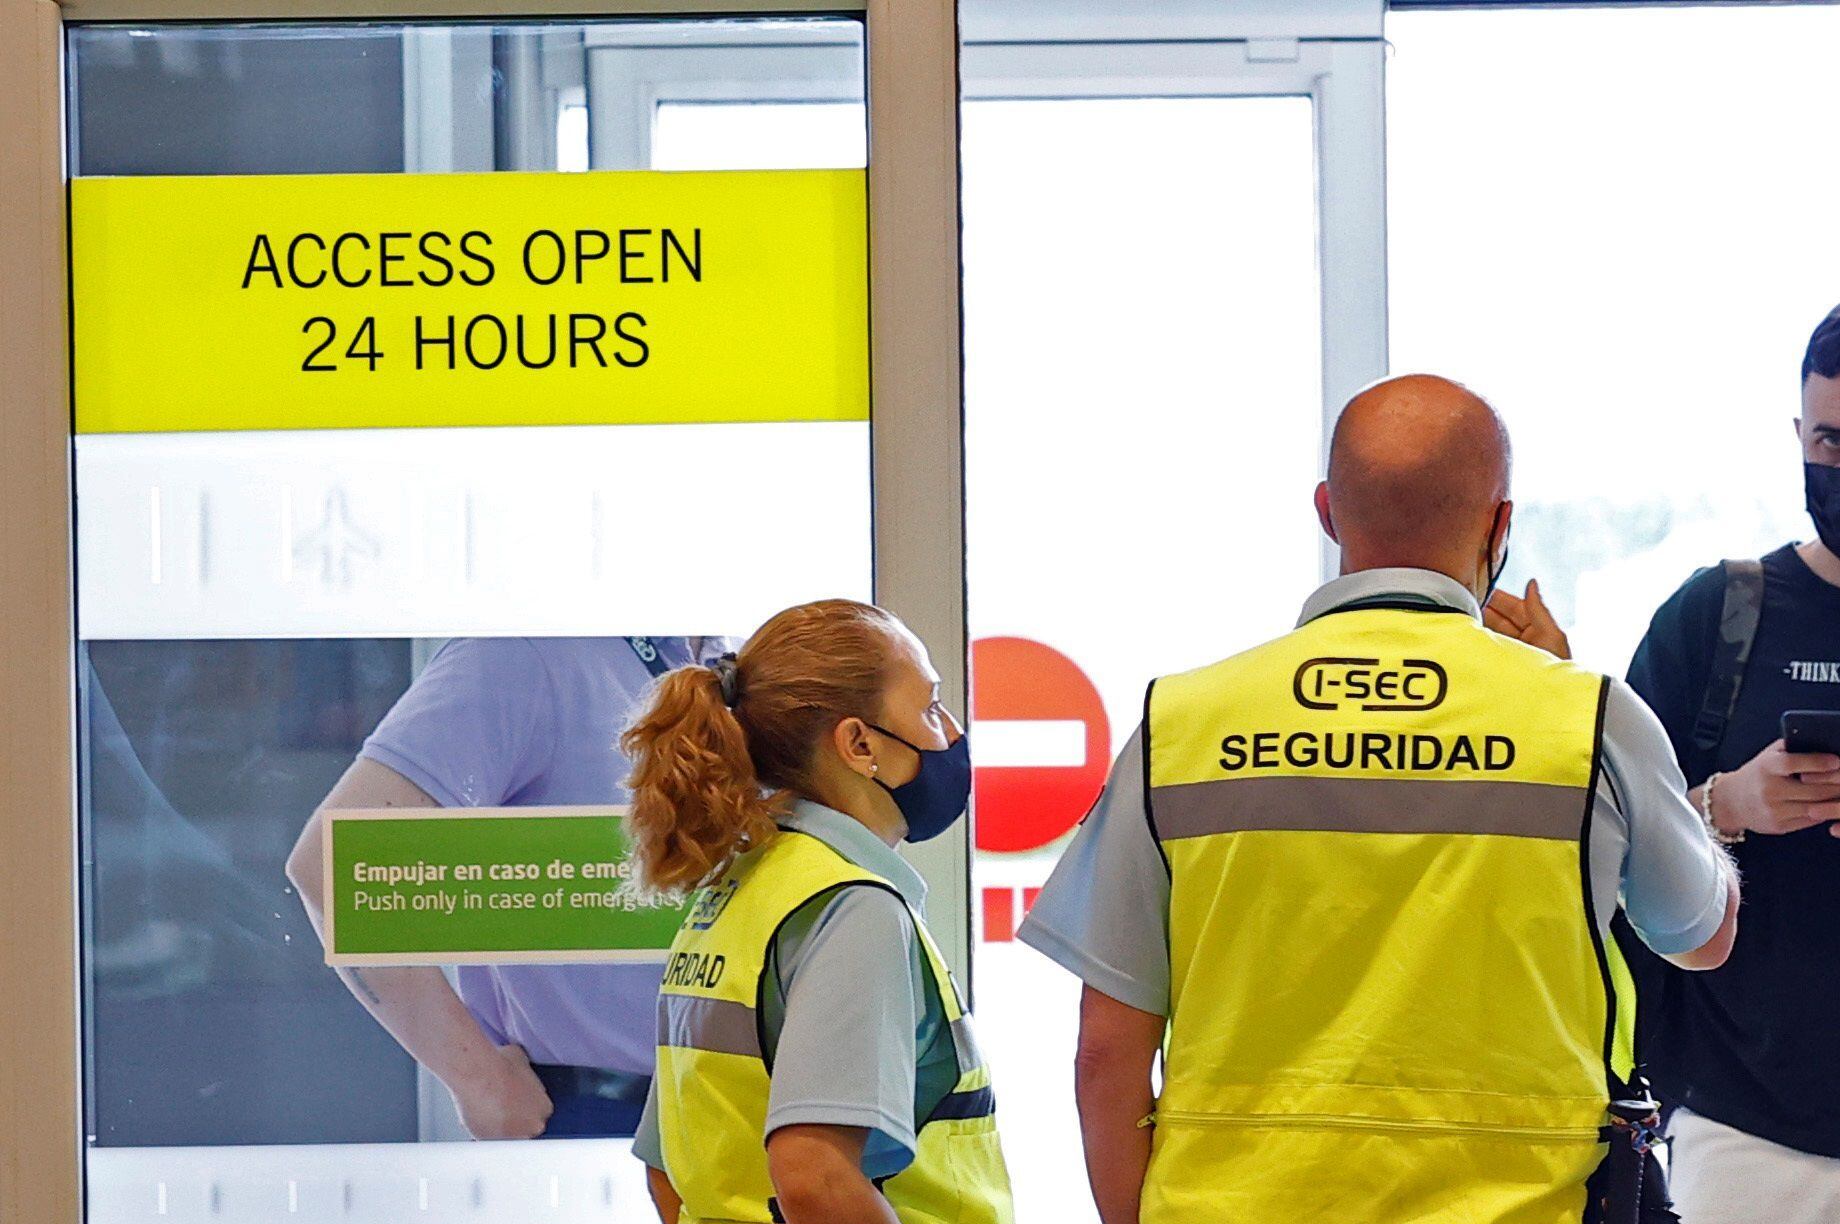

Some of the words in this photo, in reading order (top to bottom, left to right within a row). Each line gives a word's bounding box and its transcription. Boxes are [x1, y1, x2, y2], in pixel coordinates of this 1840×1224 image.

[241, 230, 496, 289] ACCESS
[522, 228, 702, 286] OPEN
[301, 315, 385, 372] 24
[415, 311, 651, 371] HOURS
[1314, 668, 1429, 701] I-SEC
[1219, 731, 1517, 772] SEGURIDAD
[353, 860, 448, 887] Empujar
[453, 863, 484, 882] en
[488, 862, 541, 881] caso
[546, 858, 576, 880] de
[354, 890, 407, 912] Push
[411, 889, 457, 915] only
[463, 888, 483, 910] in
[488, 891, 536, 910] case
[542, 887, 565, 909] of
[569, 889, 685, 912] emergcy
[661, 952, 726, 989] URIDAD
